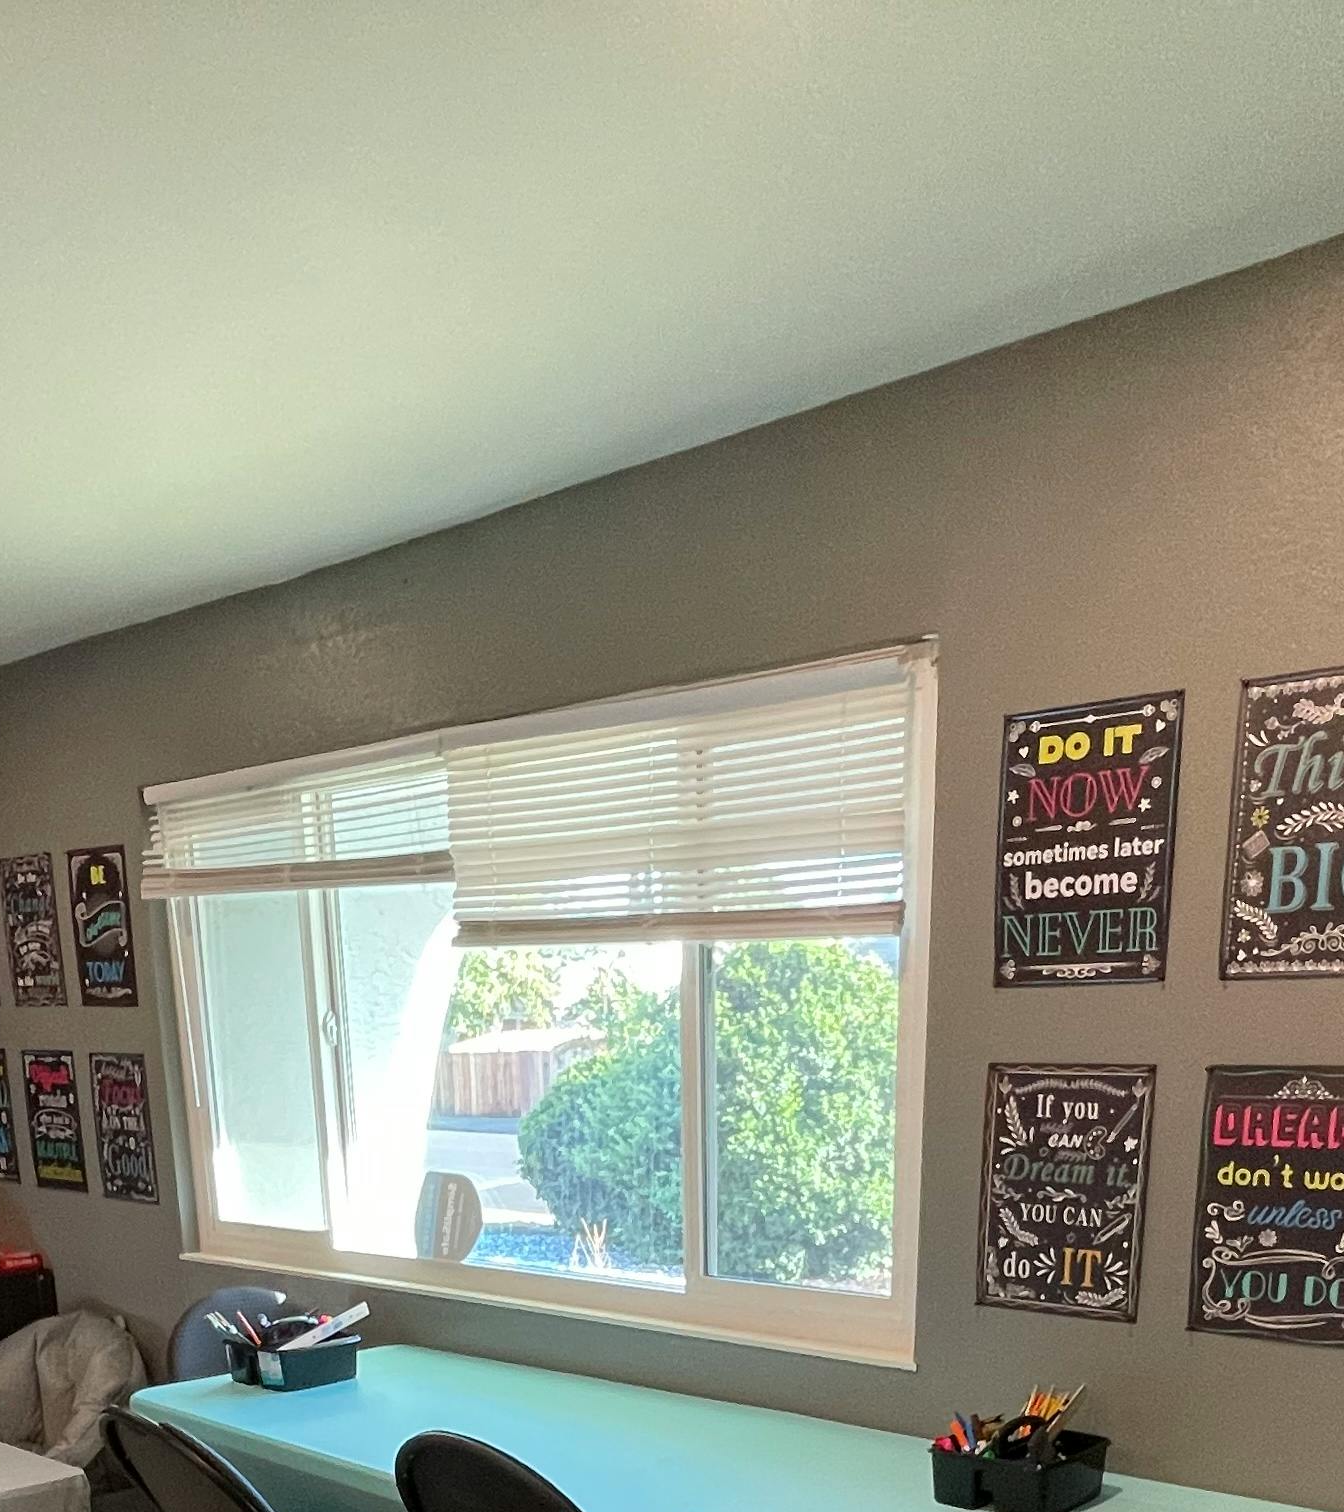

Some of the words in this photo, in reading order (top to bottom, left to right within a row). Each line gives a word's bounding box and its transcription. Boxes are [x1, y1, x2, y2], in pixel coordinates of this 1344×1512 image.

[1038, 731, 1091, 765] DO
[1102, 723, 1143, 757] IT
[1026, 764, 1151, 823] NOW
[1003, 841, 1109, 868] sometimes
[1113, 836, 1165, 858] later
[1024, 869, 1138, 900] become
[1002, 906, 1159, 958] NEVER
[1035, 1093, 1055, 1119] If
[1062, 1100, 1099, 1121] you
[1047, 1133, 1084, 1149] CAN
[1004, 1153, 1096, 1186] Dream
[1216, 1153, 1294, 1189] don't
[1019, 1202, 1057, 1224] YOU
[1062, 1205, 1103, 1228] CAN
[1246, 1198, 1344, 1230] unless
[1002, 1251, 1031, 1279] do
[1060, 1246, 1103, 1289] IT
[1219, 1267, 1288, 1303] YOU
